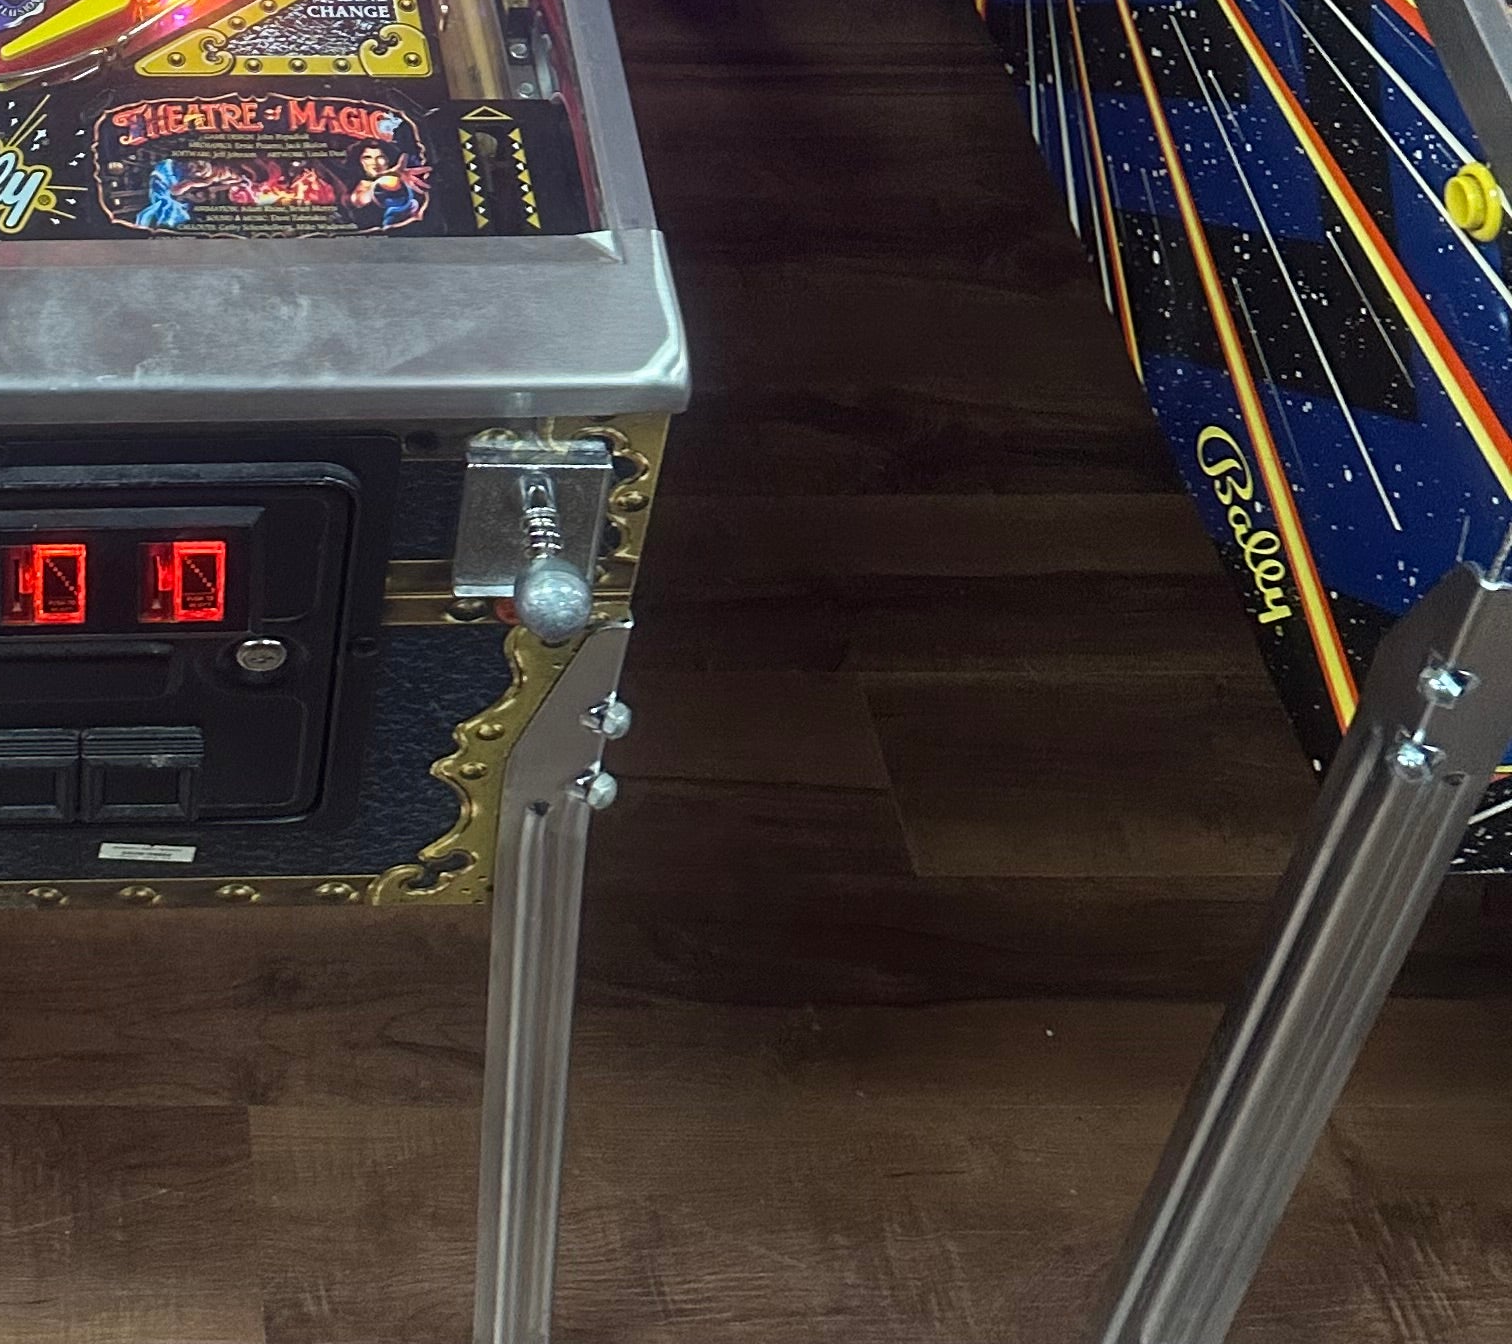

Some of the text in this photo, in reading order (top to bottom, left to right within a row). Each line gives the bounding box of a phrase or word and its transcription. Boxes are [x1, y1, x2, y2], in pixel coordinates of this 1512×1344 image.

[305, 4, 390, 20] CHANGE
[111, 100, 265, 146] THEATRE
[288, 100, 394, 144] MAGIC
[1196, 425, 1293, 625] Bally
